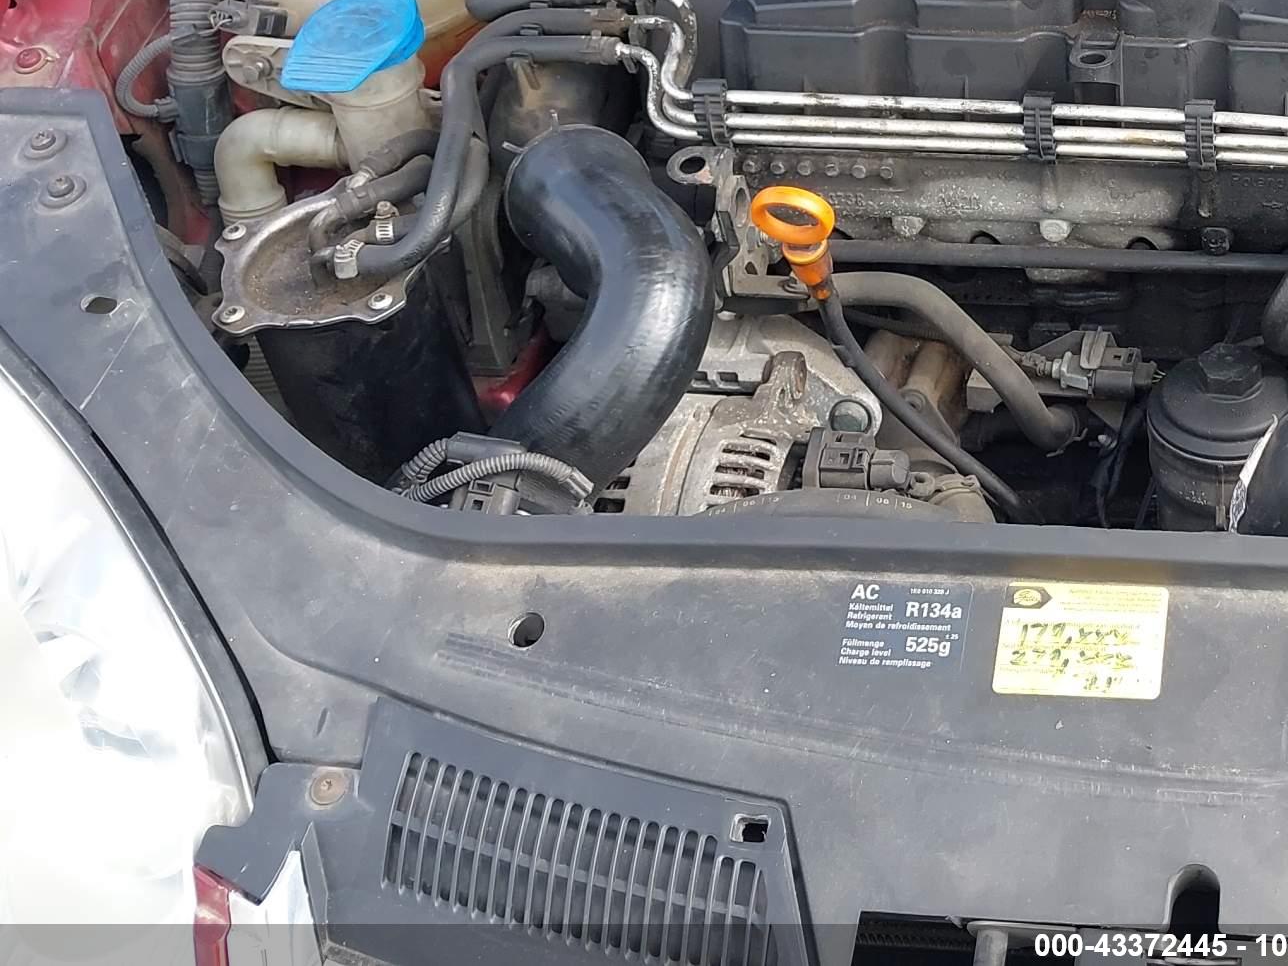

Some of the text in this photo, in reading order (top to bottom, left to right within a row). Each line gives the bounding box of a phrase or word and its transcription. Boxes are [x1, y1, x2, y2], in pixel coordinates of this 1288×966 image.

[851, 584, 880, 600] AC
[847, 611, 893, 621] Refrigerant
[905, 601, 963, 619] R134a
[845, 620, 873, 631] Moyen
[887, 622, 952, 632] refroidissement
[842, 638, 885, 649] Füllmenge
[905, 636, 951, 657] 525g
[840, 647, 892, 657] Charge level
[839, 656, 932, 669] Niveau de remplissage
